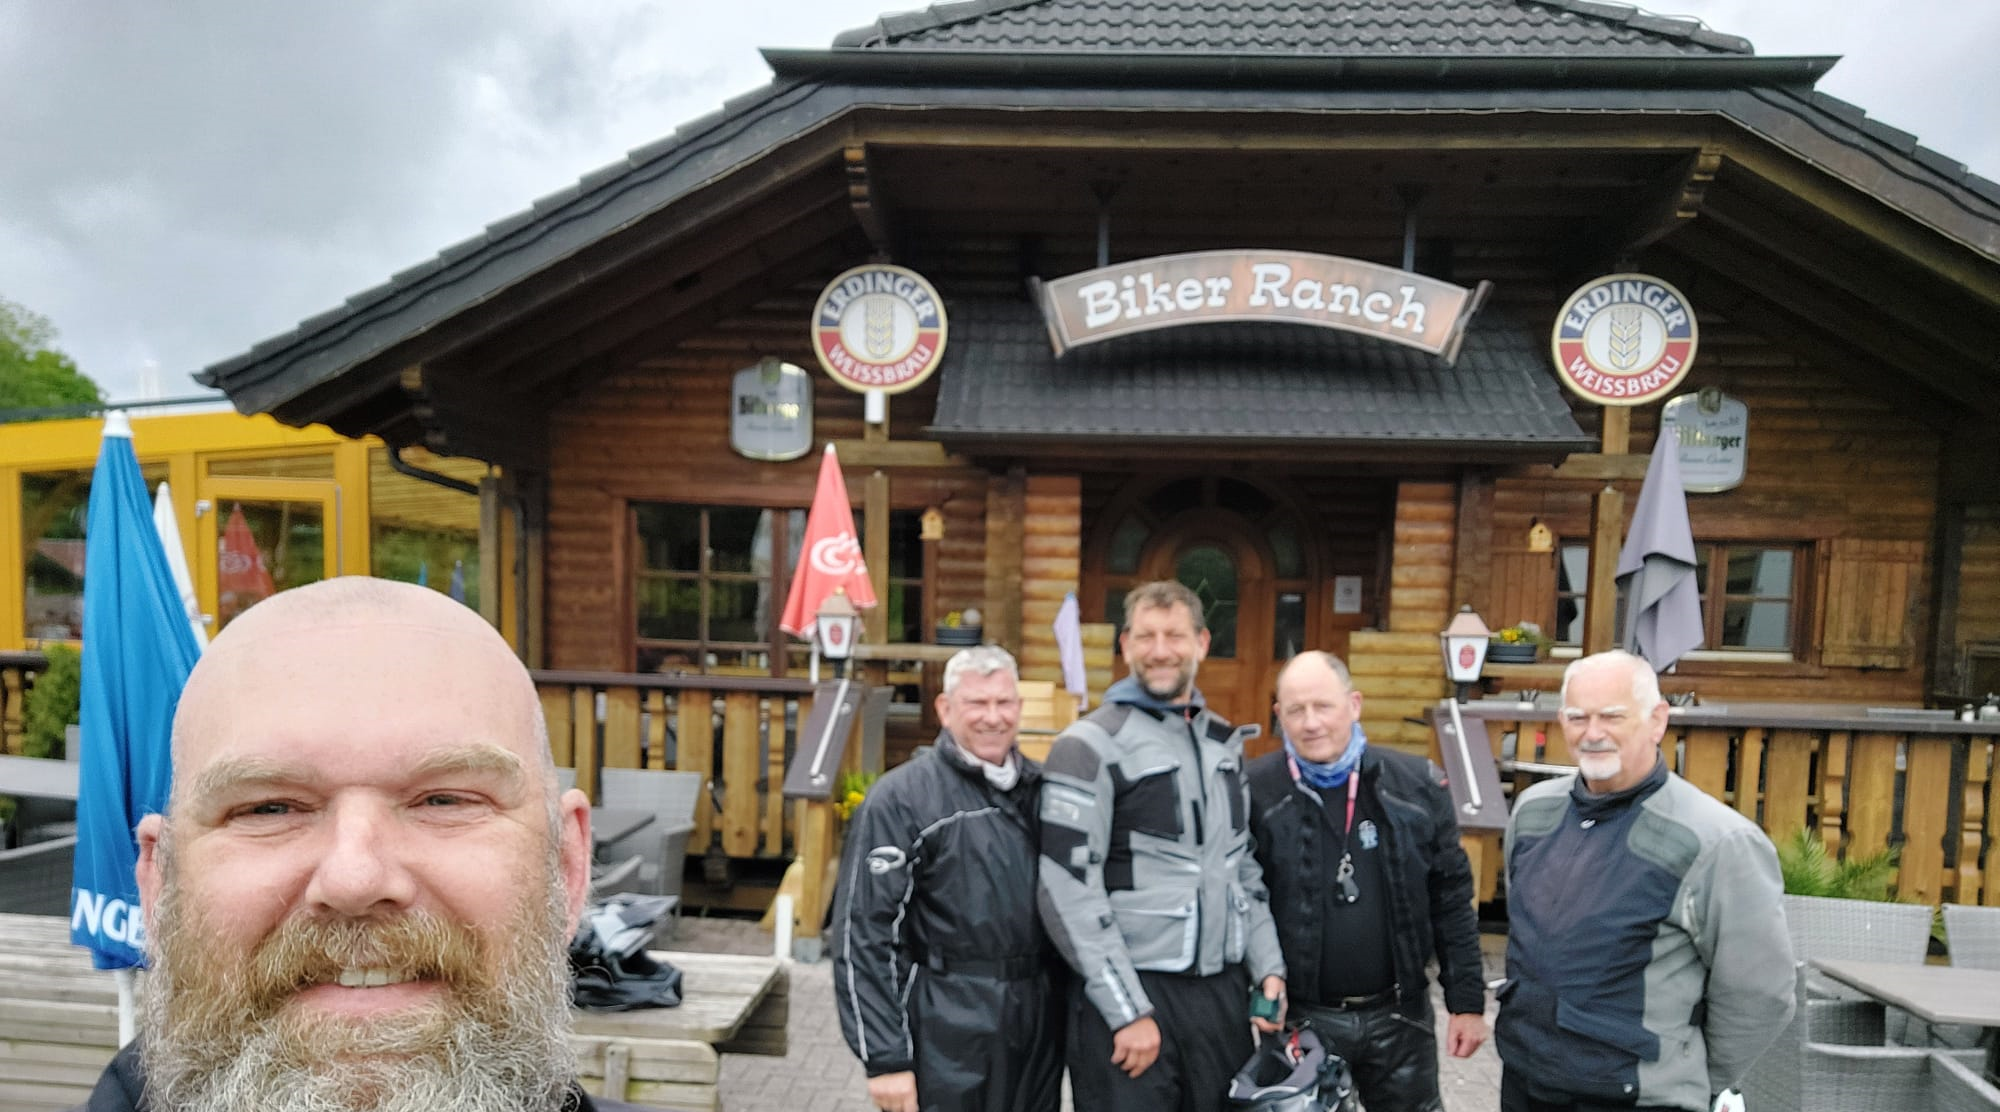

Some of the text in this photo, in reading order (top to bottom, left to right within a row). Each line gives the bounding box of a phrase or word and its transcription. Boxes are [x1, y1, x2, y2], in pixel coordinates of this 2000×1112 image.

[823, 272, 935, 321] ERDINGER
[1077, 261, 1426, 334] Biker Ranch
[1565, 281, 1686, 331] ERDINGER
